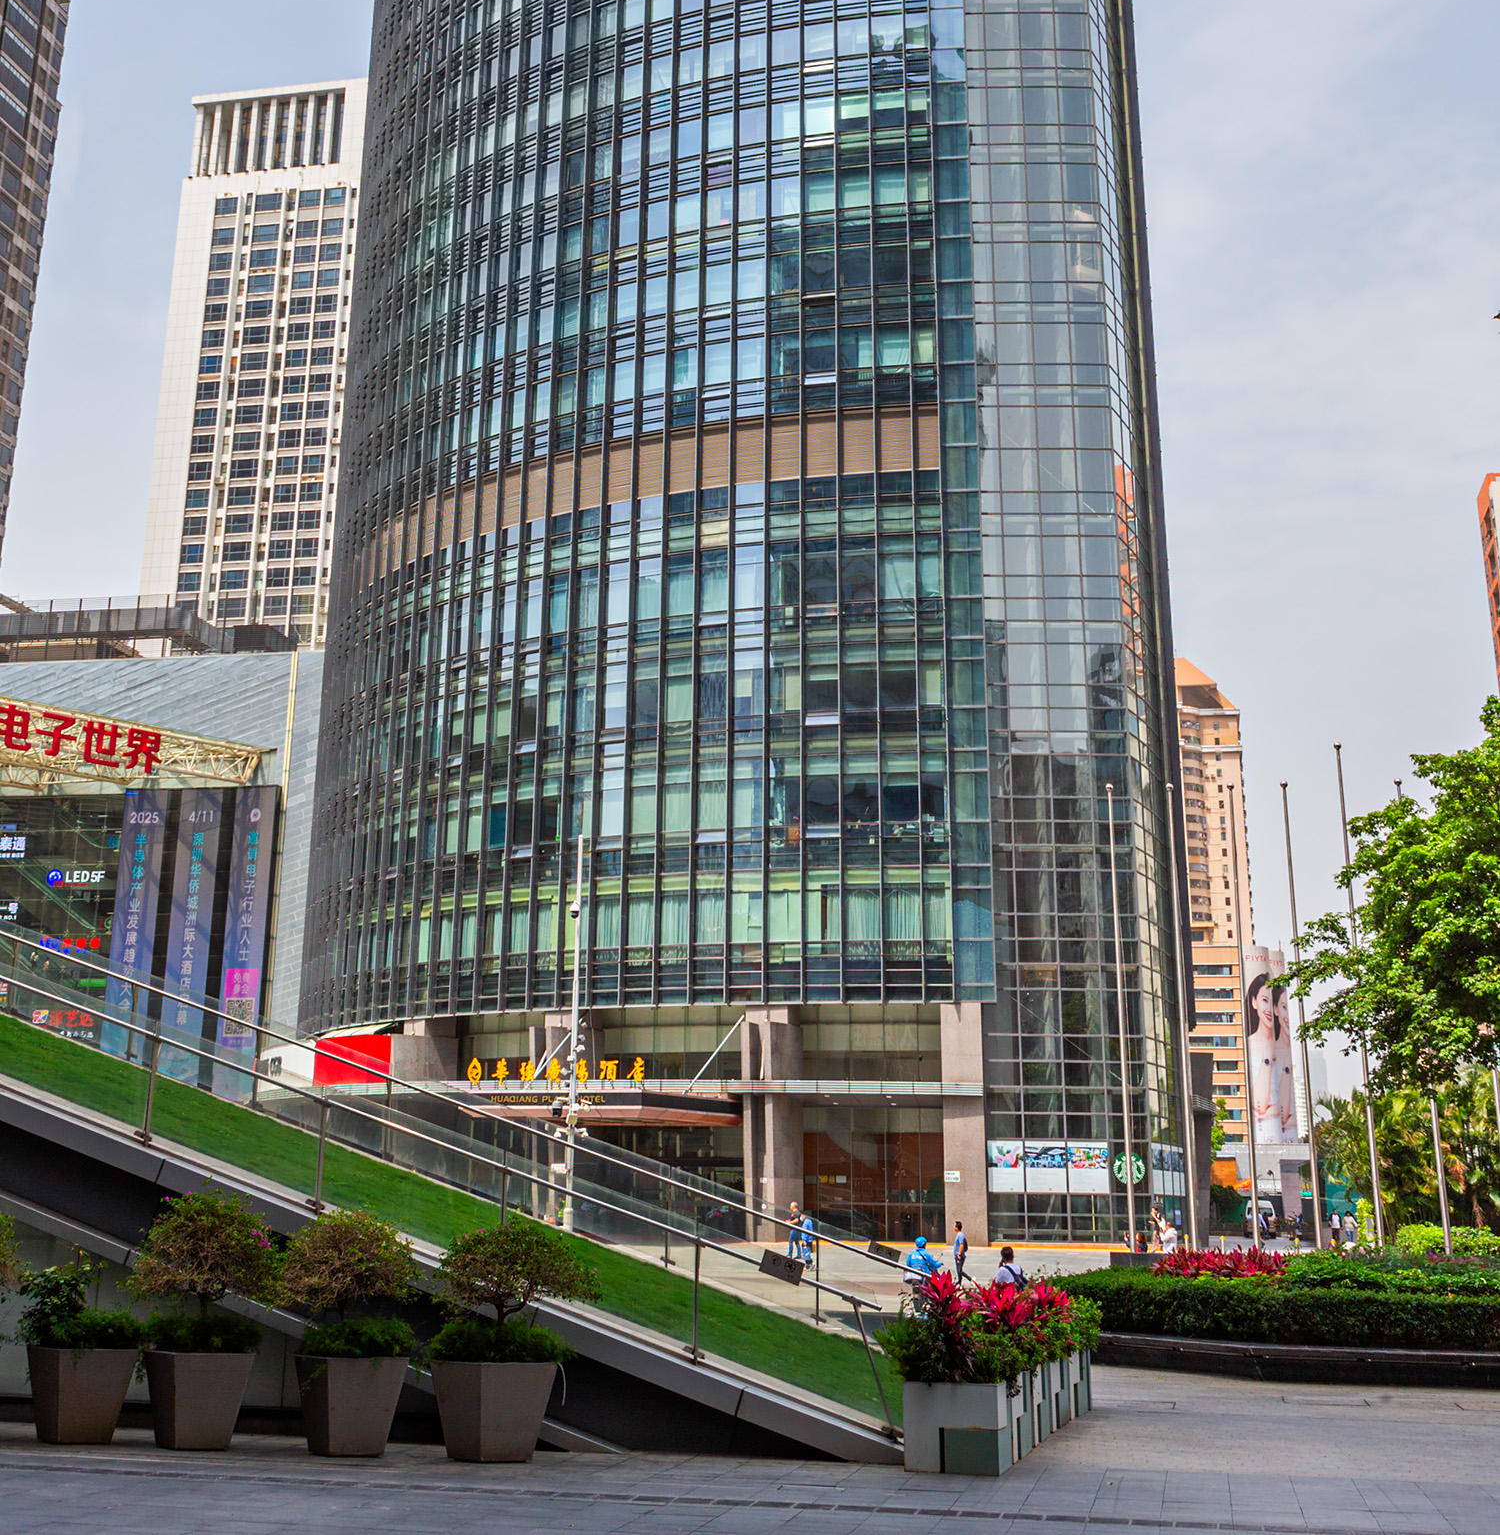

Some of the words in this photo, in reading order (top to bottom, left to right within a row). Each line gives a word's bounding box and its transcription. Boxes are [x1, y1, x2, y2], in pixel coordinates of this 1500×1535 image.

[0, 704, 162, 774] 电子世界
[130, 811, 159, 824] 2025
[188, 811, 214, 824] 4/11
[238, 830, 259, 961] 邀请电子行业人士
[491, 1095, 538, 1103] HUAQIANG
